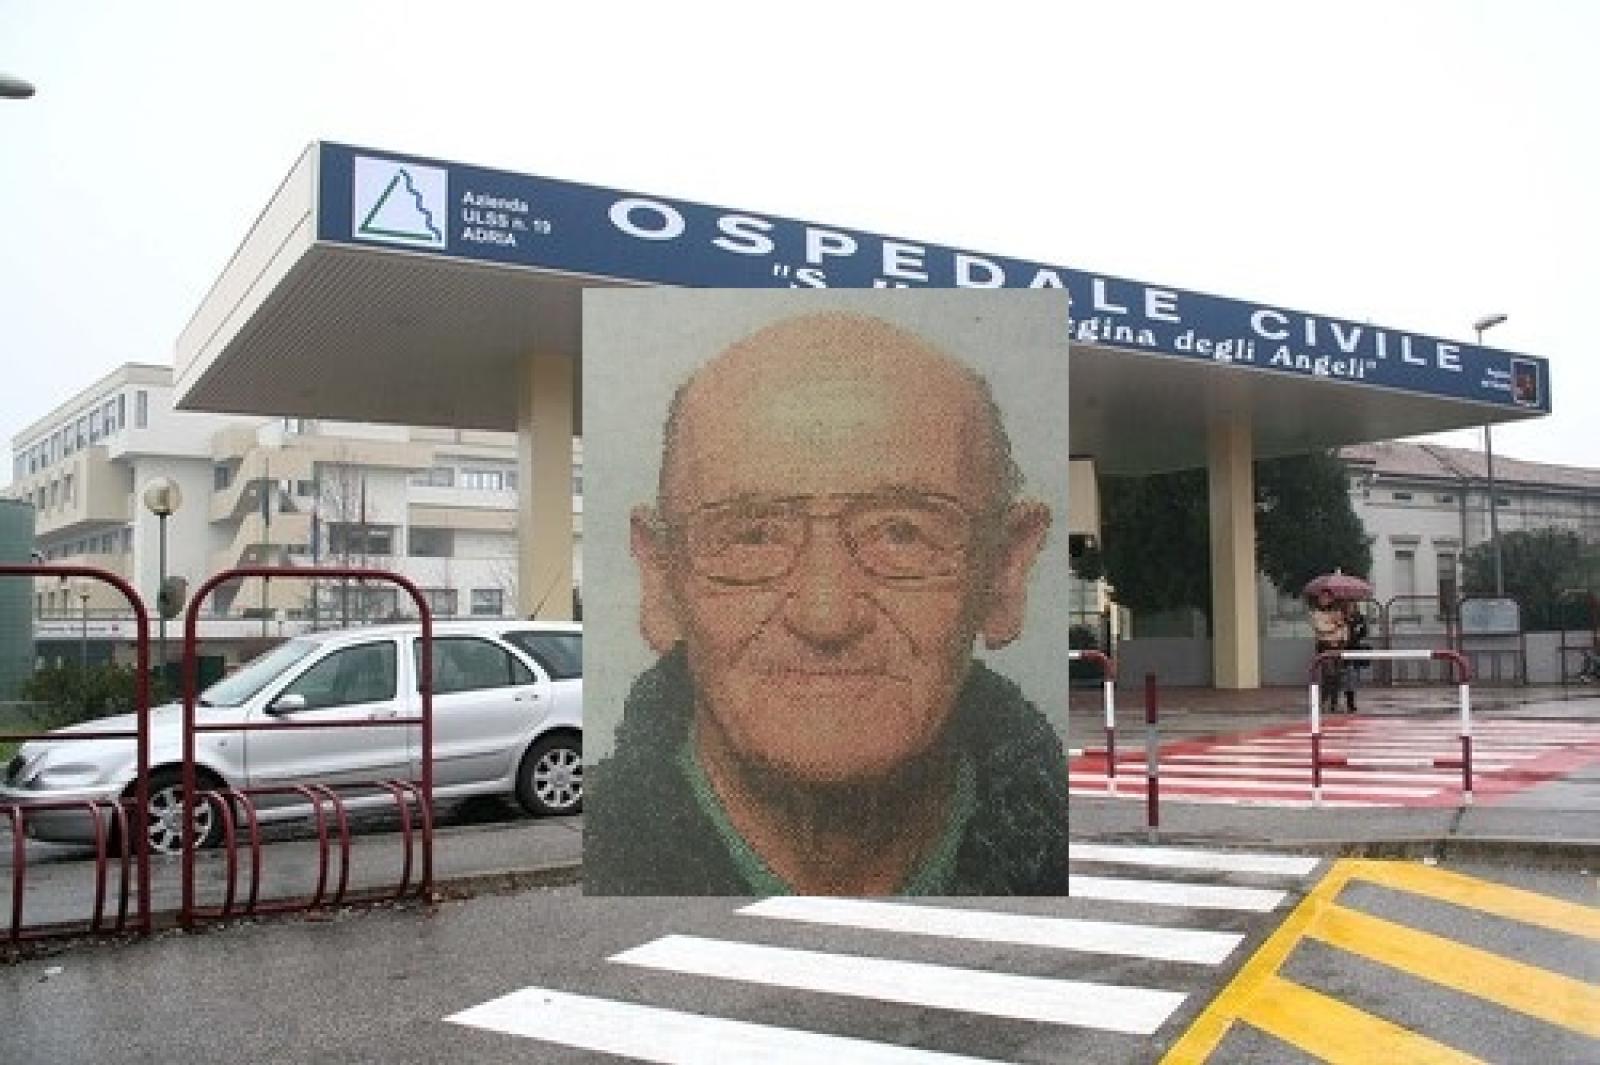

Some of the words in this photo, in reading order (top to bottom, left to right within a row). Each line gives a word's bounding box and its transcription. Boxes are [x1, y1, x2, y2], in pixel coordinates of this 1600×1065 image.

[461, 190, 529, 213] Azienda
[460, 226, 518, 247] ADRIA
[1174, 329, 1256, 363] degli
[1250, 309, 1463, 372] CIVILE
